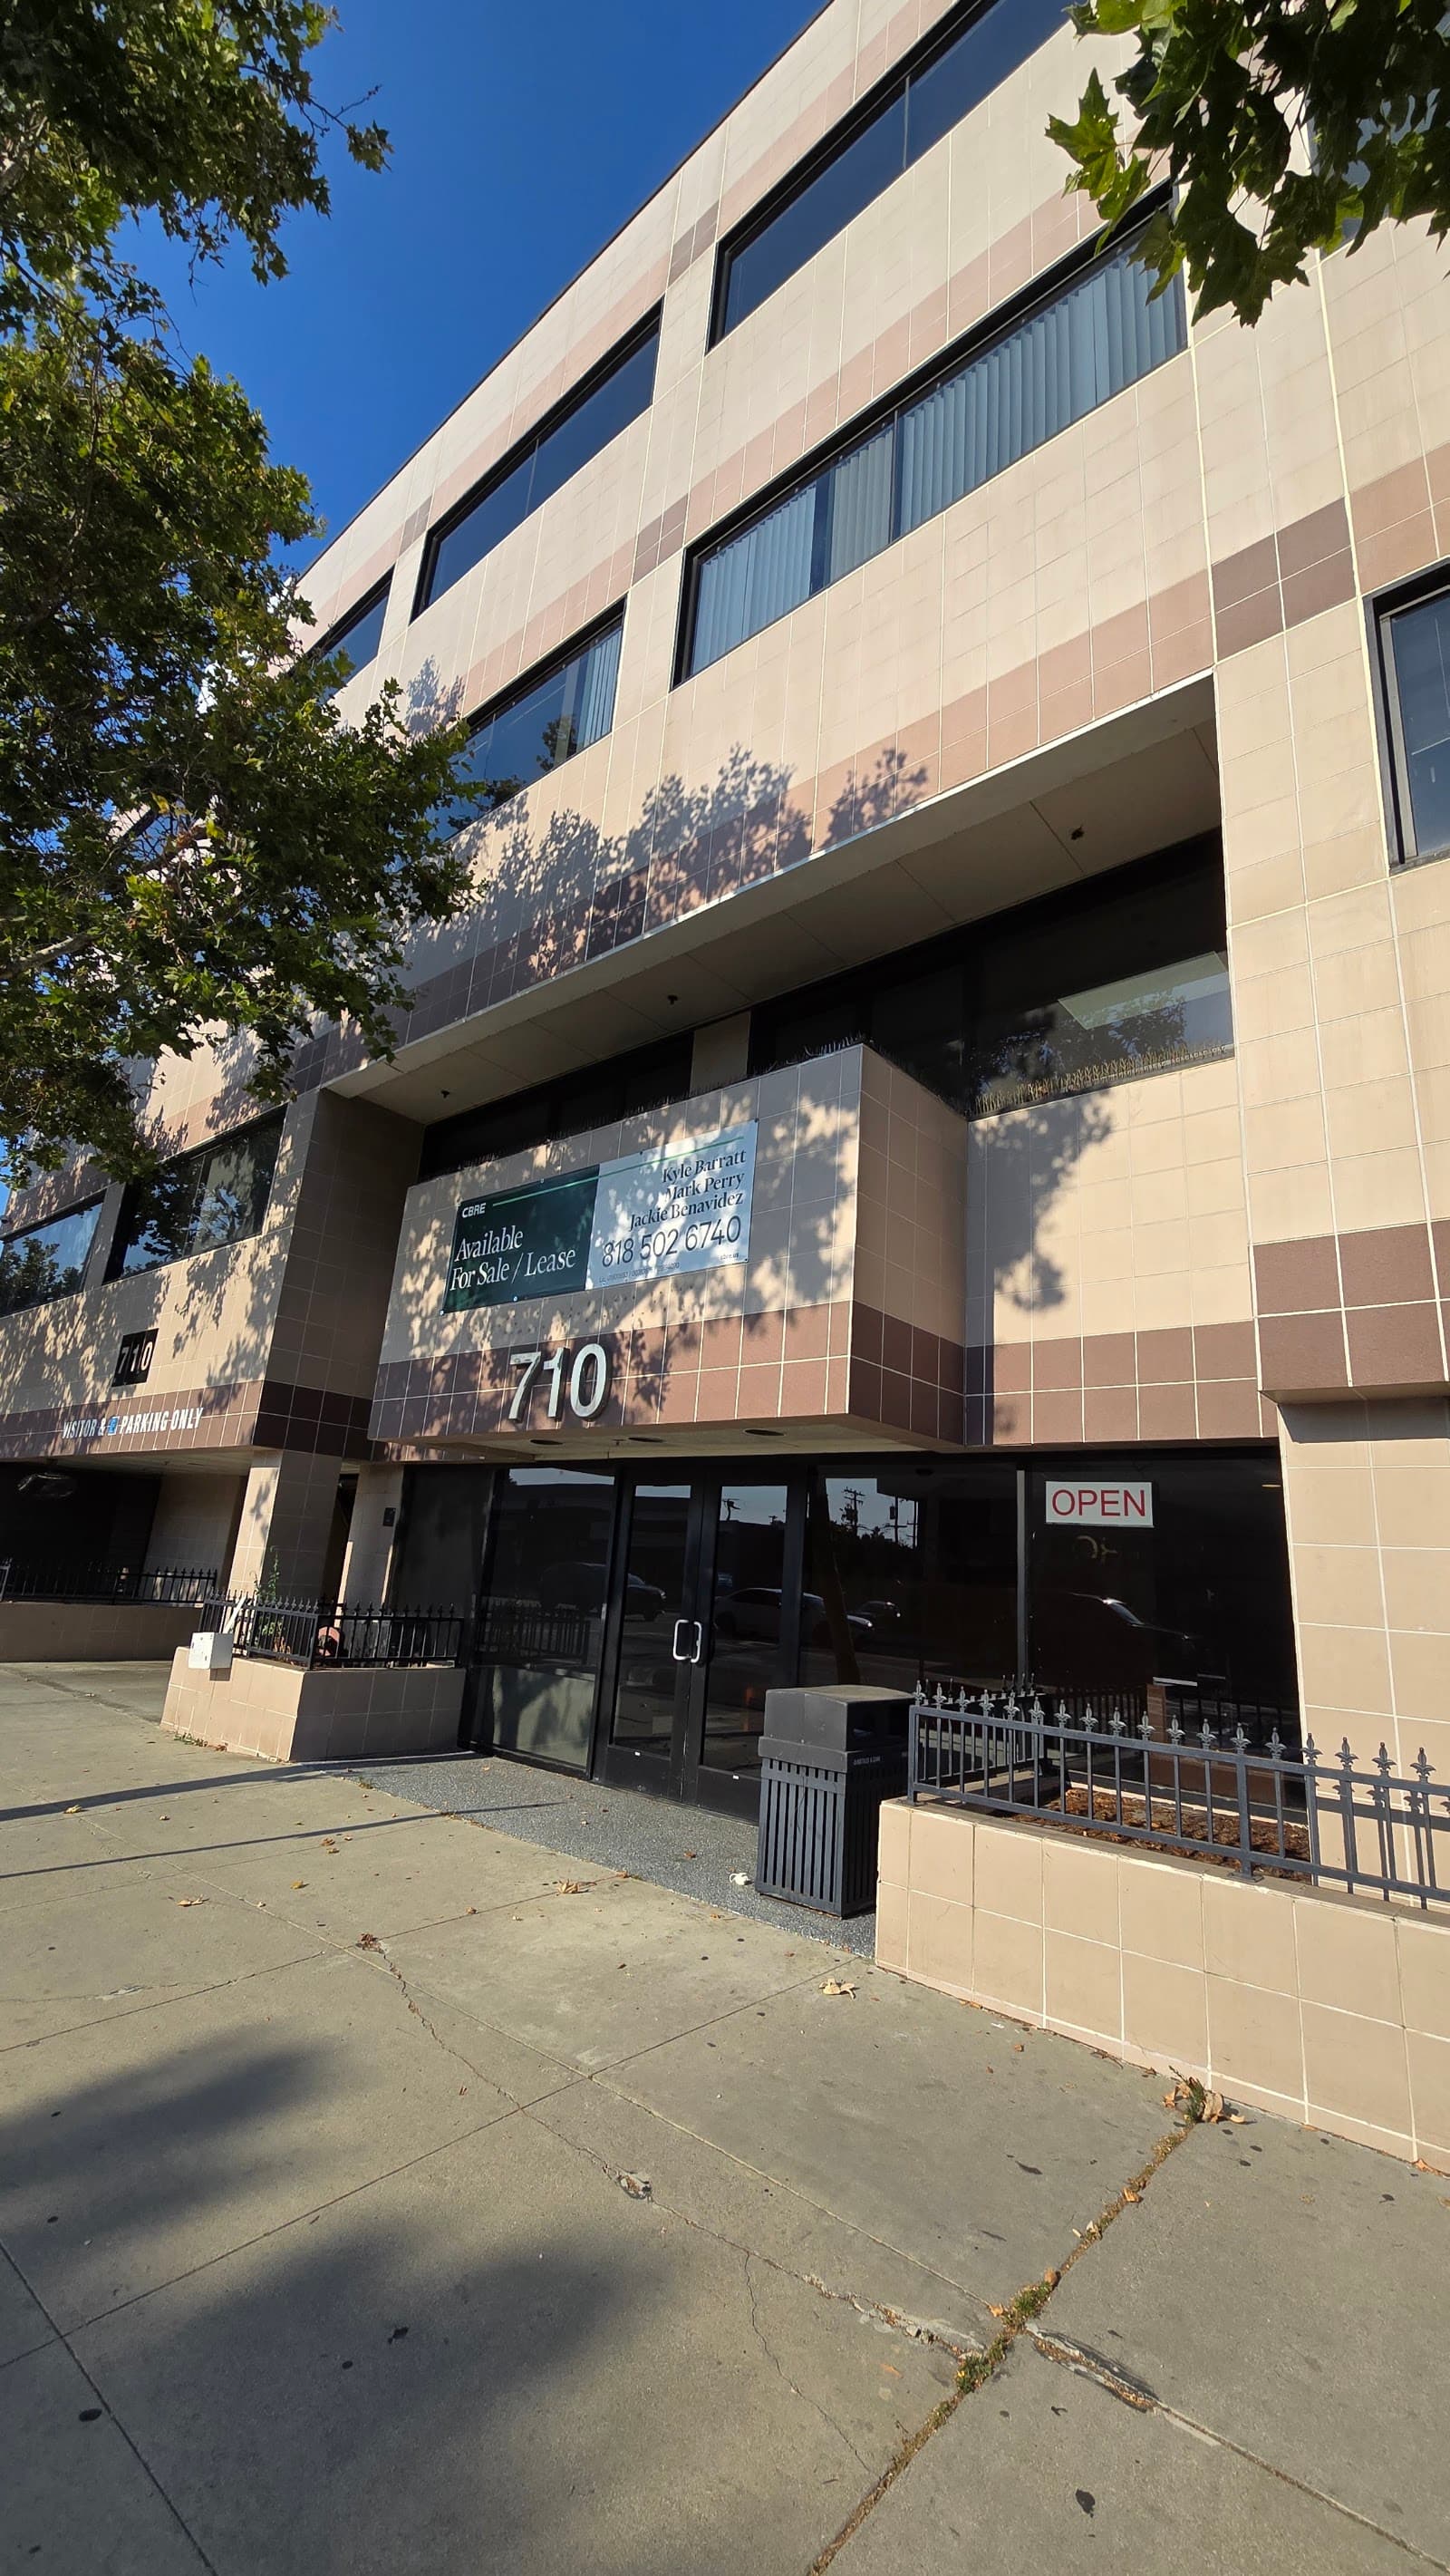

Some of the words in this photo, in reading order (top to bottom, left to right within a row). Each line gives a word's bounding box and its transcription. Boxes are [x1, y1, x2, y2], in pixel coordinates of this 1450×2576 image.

[662, 1163, 692, 1184] Kyle
[695, 1150, 746, 1172] Barratt
[667, 1180, 701, 1201] Mark
[705, 1173, 745, 1194] Perry
[461, 1203, 486, 1218] CBRE
[630, 1207, 668, 1232] Jackie
[671, 1192, 743, 1219] Benavidez
[454, 1225, 524, 1262] Available
[602, 1237, 633, 1267] 818
[640, 1228, 679, 1260] 502
[685, 1215, 741, 1251] 6740
[450, 1267, 476, 1291] For
[477, 1257, 509, 1285] Sale
[511, 1253, 524, 1284] /
[524, 1249, 575, 1277] Lease
[117, 1341, 153, 1374] 710
[508, 1343, 606, 1419] 710
[62, 1420, 97, 1439] VISITOR
[97, 1418, 107, 1436] &
[119, 1410, 169, 1435] PARKING
[169, 1407, 204, 1430] ONLY
[1051, 1489, 1146, 1516] OPEN
